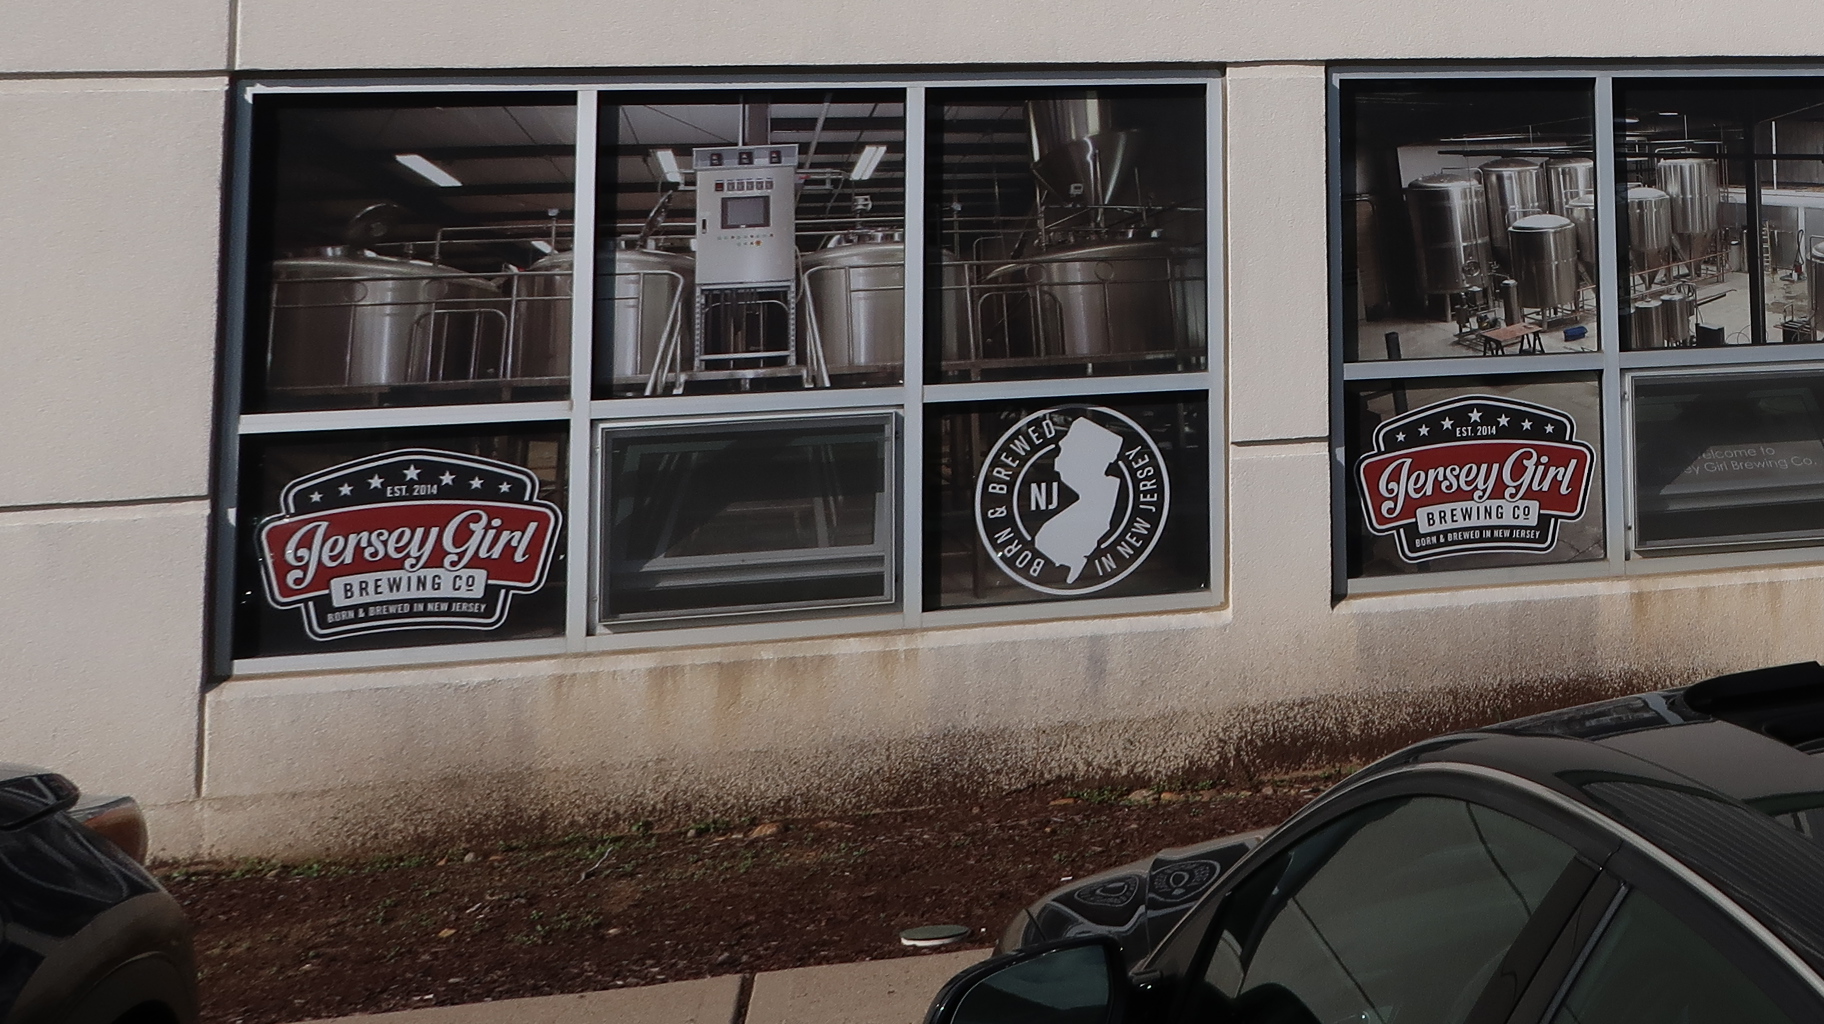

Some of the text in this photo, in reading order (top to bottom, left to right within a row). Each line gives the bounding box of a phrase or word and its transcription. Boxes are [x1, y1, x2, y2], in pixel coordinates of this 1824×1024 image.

[1456, 425, 1496, 437] EST. 2014
[1698, 445, 1775, 460] elcome to
[1704, 461, 1728, 473] Girl
[1731, 458, 1788, 471] Brewing
[1790, 456, 1817, 467] Co.
[386, 484, 438, 497] EST. 2014
[1378, 448, 1579, 518] Jersey Girl
[987, 418, 1056, 577] BORN & BREWED
[1030, 481, 1059, 512] NJ
[1094, 445, 1158, 577] IN NEW JERSEY
[1426, 505, 1504, 527] BREWING
[284, 509, 538, 590] Jersey Girl
[1415, 529, 1540, 548] BORN & BREWED IN NEW JERSEY
[343, 575, 442, 600] BREWING
[327, 602, 487, 624] BORN & BREWED IN NEW JERSEY
